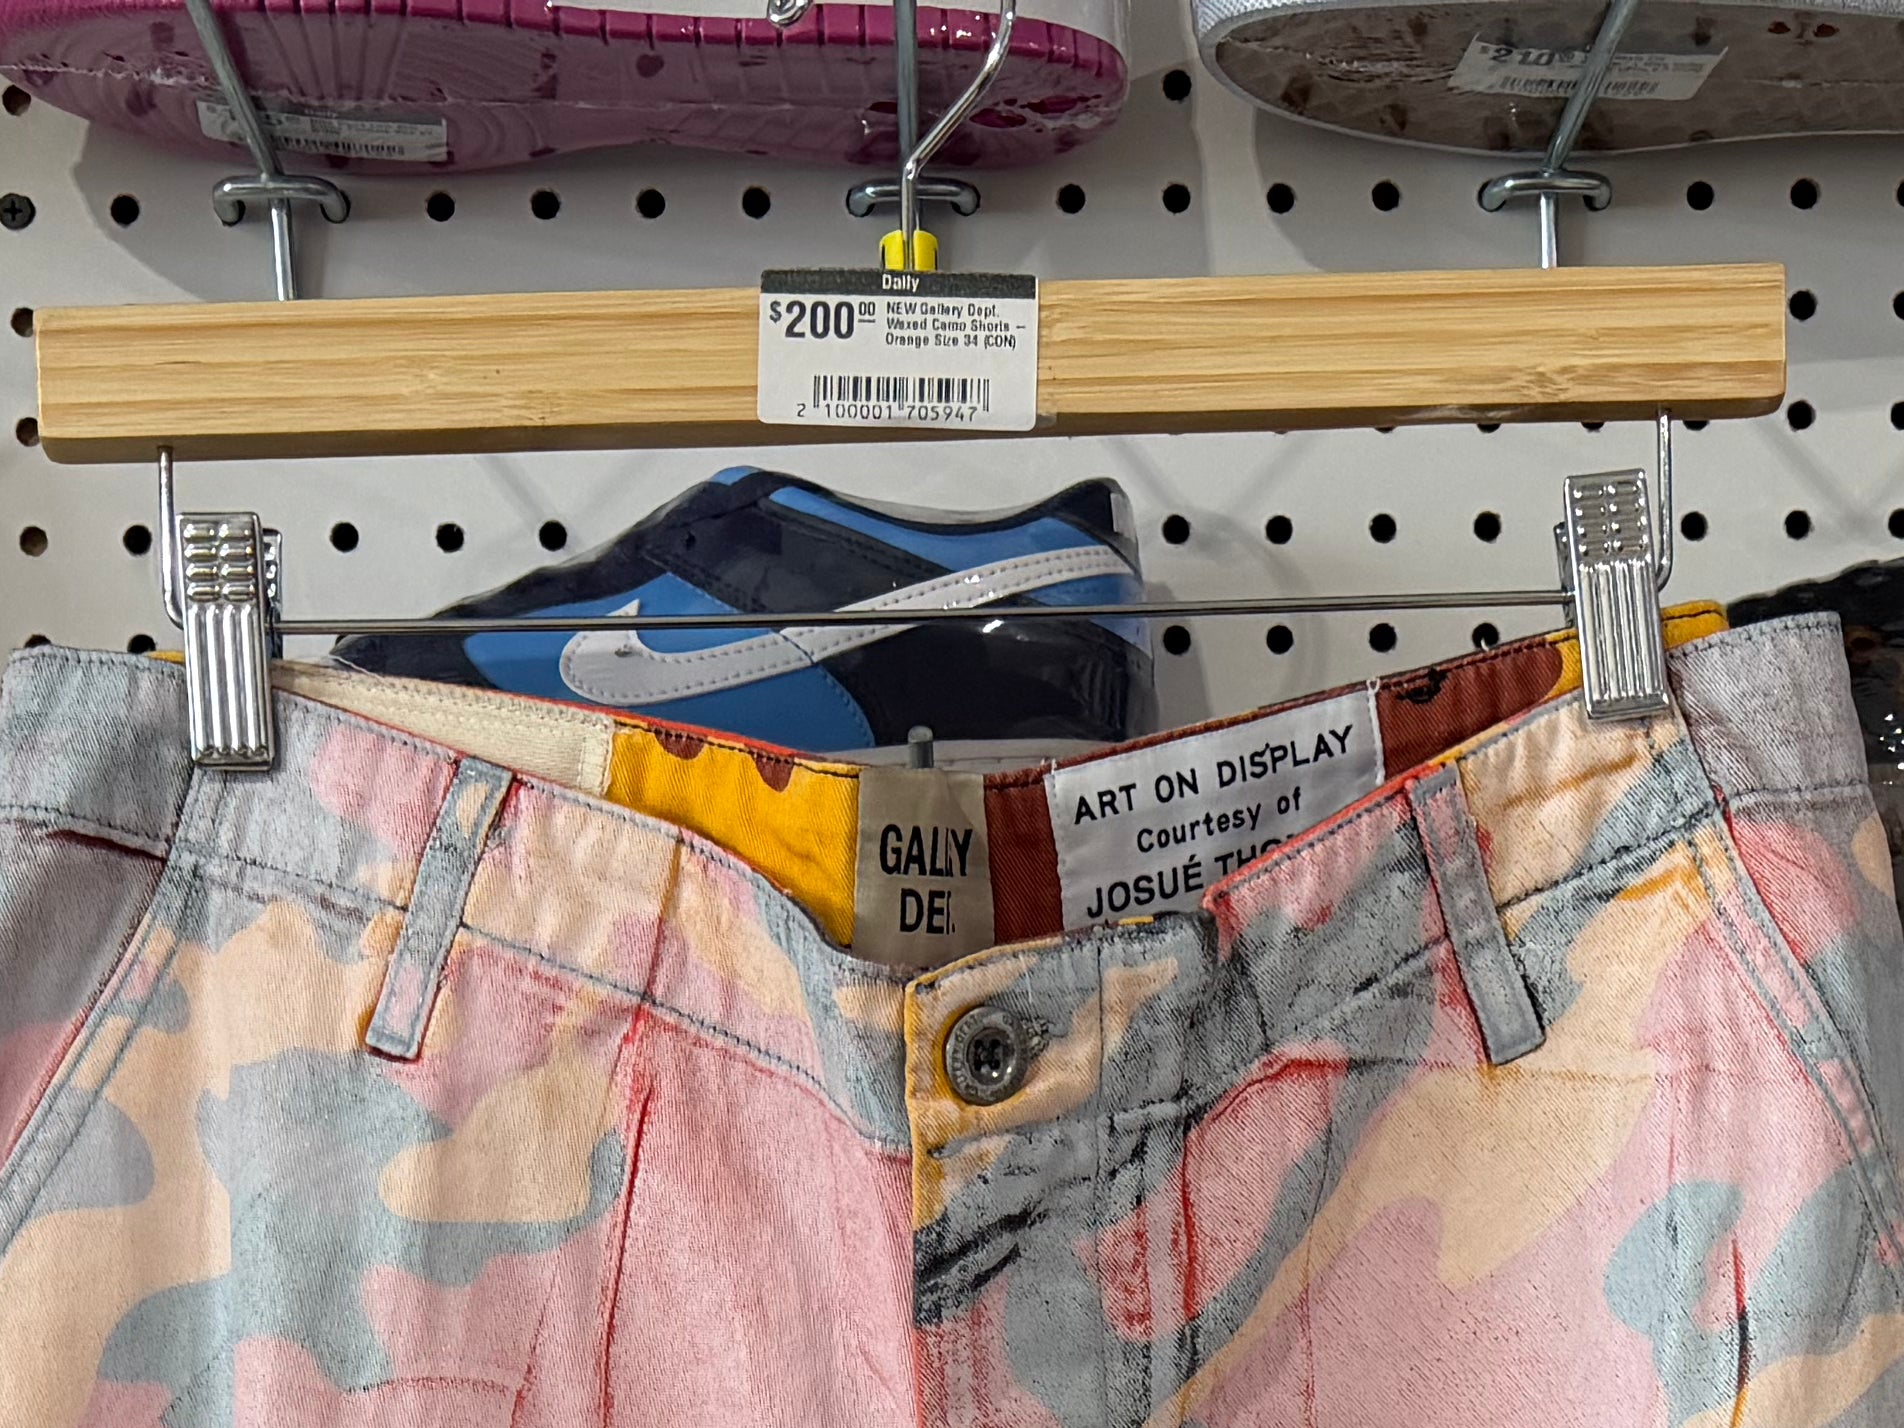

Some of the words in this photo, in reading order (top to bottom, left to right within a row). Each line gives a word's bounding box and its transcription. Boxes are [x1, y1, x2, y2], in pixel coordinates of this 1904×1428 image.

[886, 301, 917, 315] NEW
[920, 302, 963, 319] Gallery
[886, 317, 927, 330] Waxed
[932, 318, 967, 332] Camo
[970, 319, 1010, 332] Shorts
[885, 332, 930, 349] Orange
[934, 333, 959, 347] Size
[963, 333, 979, 347] 34
[906, 405, 978, 422] 705947
[1073, 783, 1139, 826] ART
[1154, 767, 1199, 805] ON
[1216, 725, 1355, 789] DISPLAY
[1136, 798, 1262, 854] Courtesy
[1276, 788, 1303, 816] of
[1086, 855, 1206, 919] JOSUÉ
